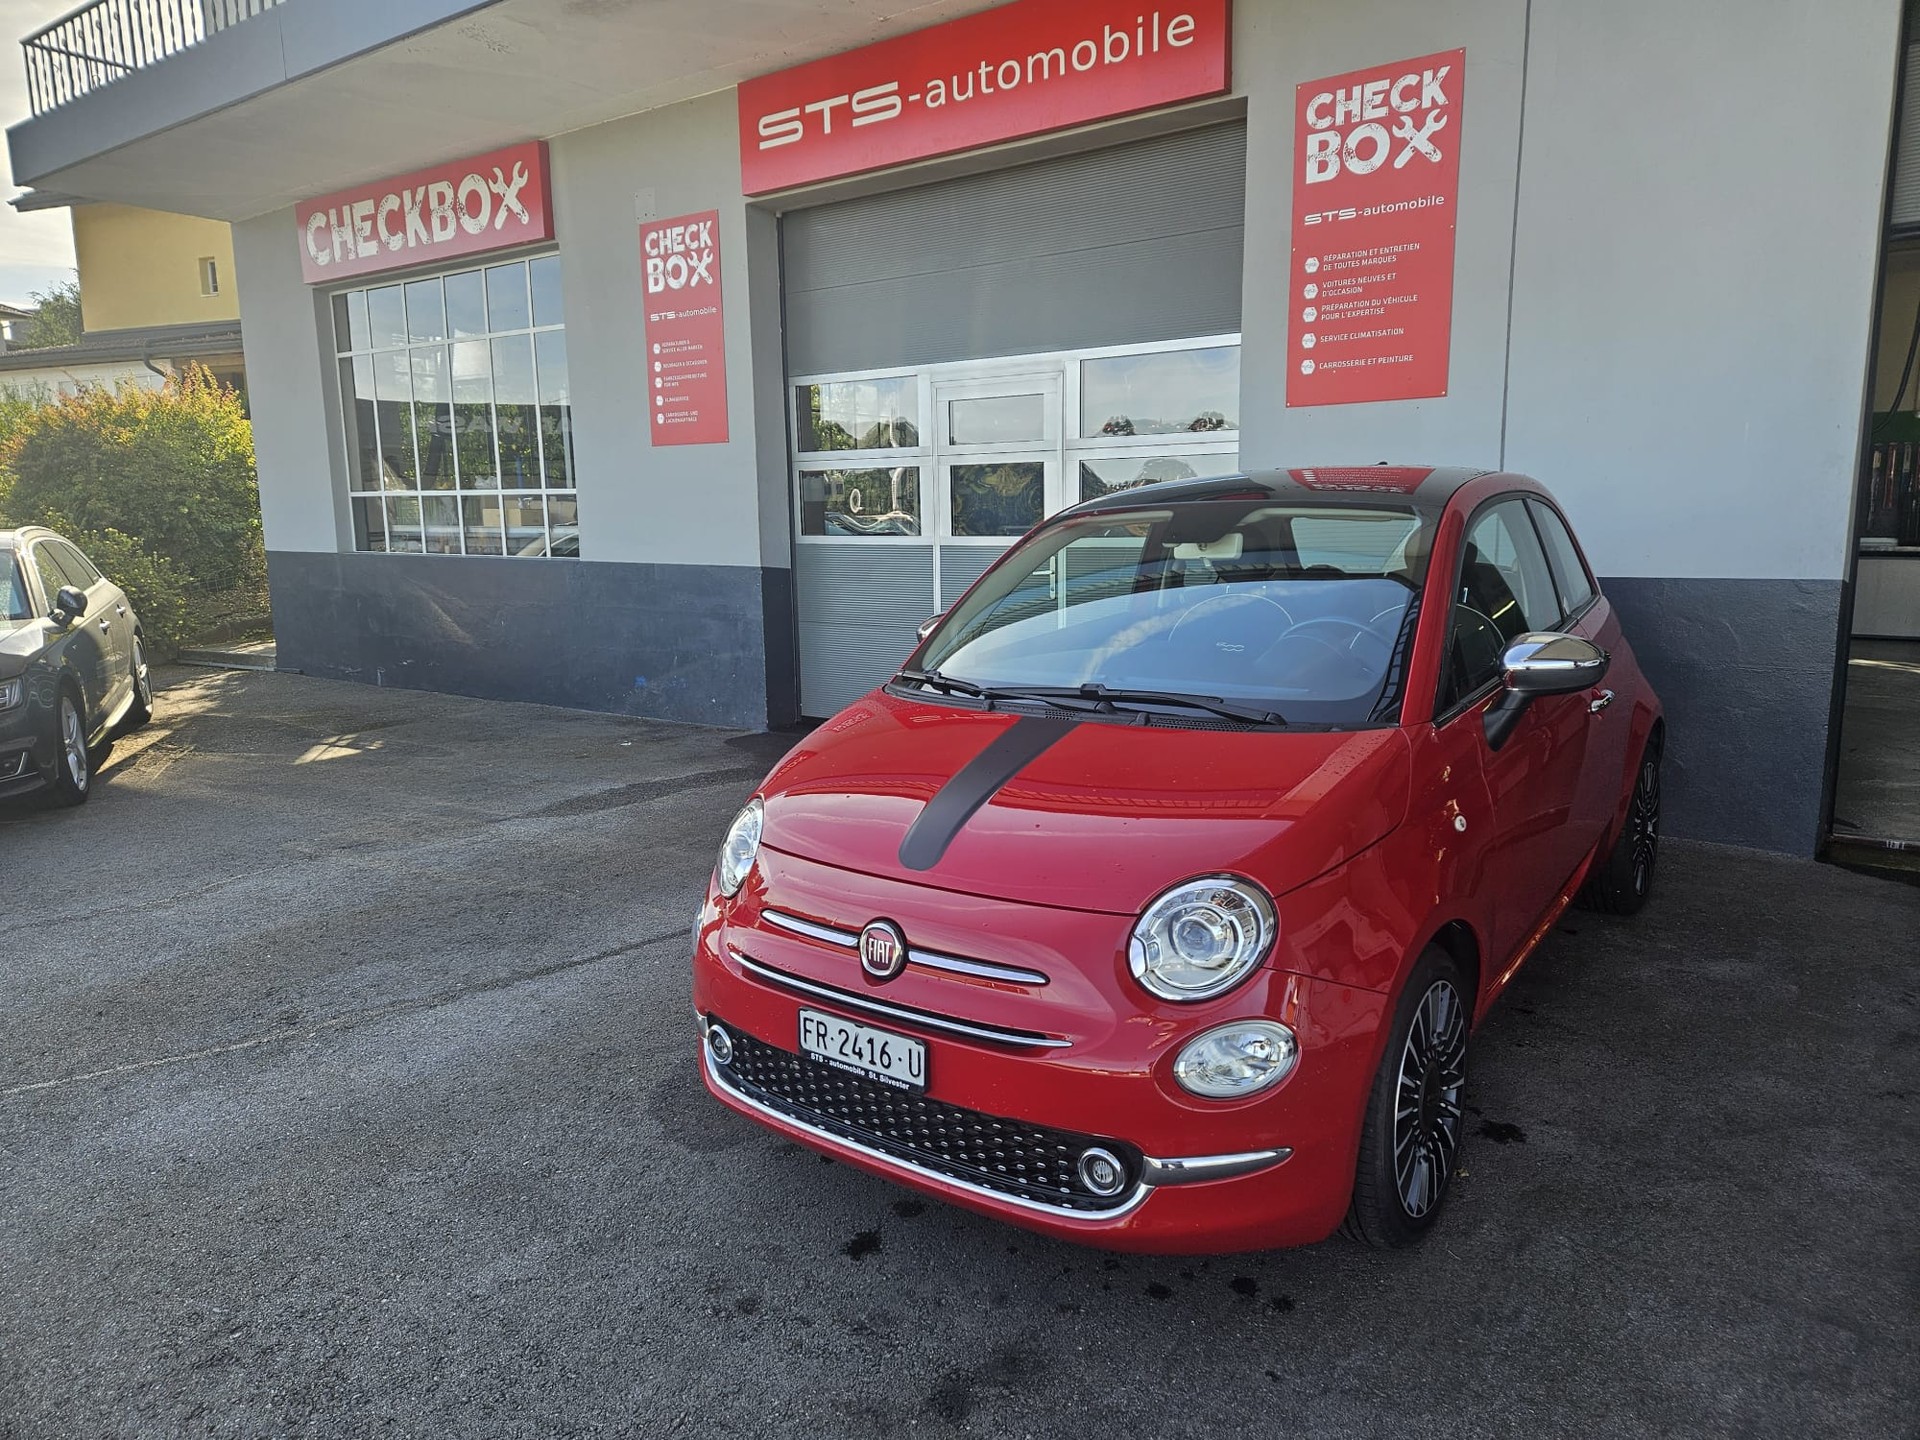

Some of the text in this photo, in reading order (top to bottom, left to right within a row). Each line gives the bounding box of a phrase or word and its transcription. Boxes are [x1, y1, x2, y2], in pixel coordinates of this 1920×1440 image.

[758, 11, 1196, 150] STS-automobile
[1306, 65, 1451, 130] CHECK
[1305, 108, 1448, 185] BOX
[306, 160, 530, 266] CHECKBOX
[1304, 195, 1445, 226] STS-automobile
[645, 220, 713, 257] CHECK
[1369, 248, 1378, 256] ET
[1379, 243, 1420, 255] ENTRETIEN
[646, 249, 714, 294] BOX
[1334, 260, 1360, 270] TOUTES
[1361, 255, 1397, 266] MARQUES
[1322, 272, 1397, 288] VOITURES NEUVES ET
[1371, 298, 1381, 306] DU
[1321, 313, 1340, 321] POUR
[1320, 327, 1405, 343] SERVICE CLIMATISATION
[1319, 354, 1414, 369] CARROSSERIE ET PEINTURE
[868, 937, 893, 964] FIAT
[810, 1052, 824, 1063] STS
[828, 1059, 866, 1076] automobile
